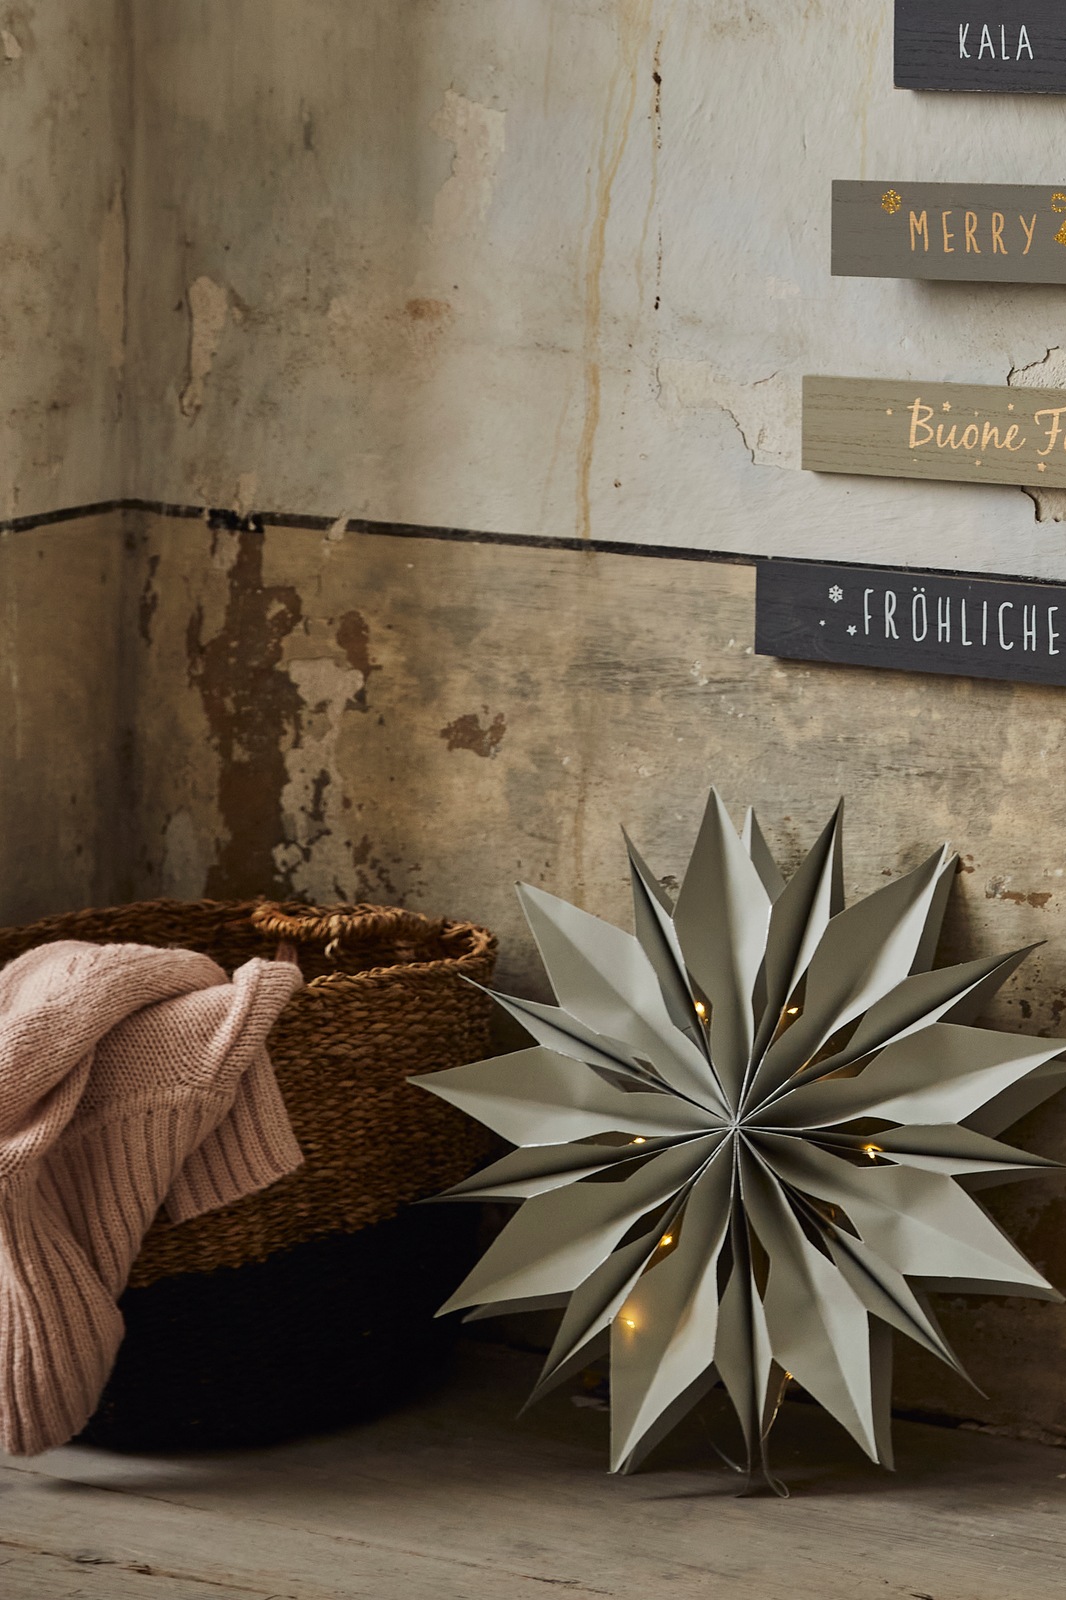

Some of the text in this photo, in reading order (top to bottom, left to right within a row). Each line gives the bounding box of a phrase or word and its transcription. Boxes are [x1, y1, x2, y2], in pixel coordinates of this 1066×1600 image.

[958, 22, 1034, 61] KALA
[908, 211, 1037, 255] MERRY
[907, 397, 1026, 452] Buone
[864, 587, 1061, 656] FRÖHLICHE
